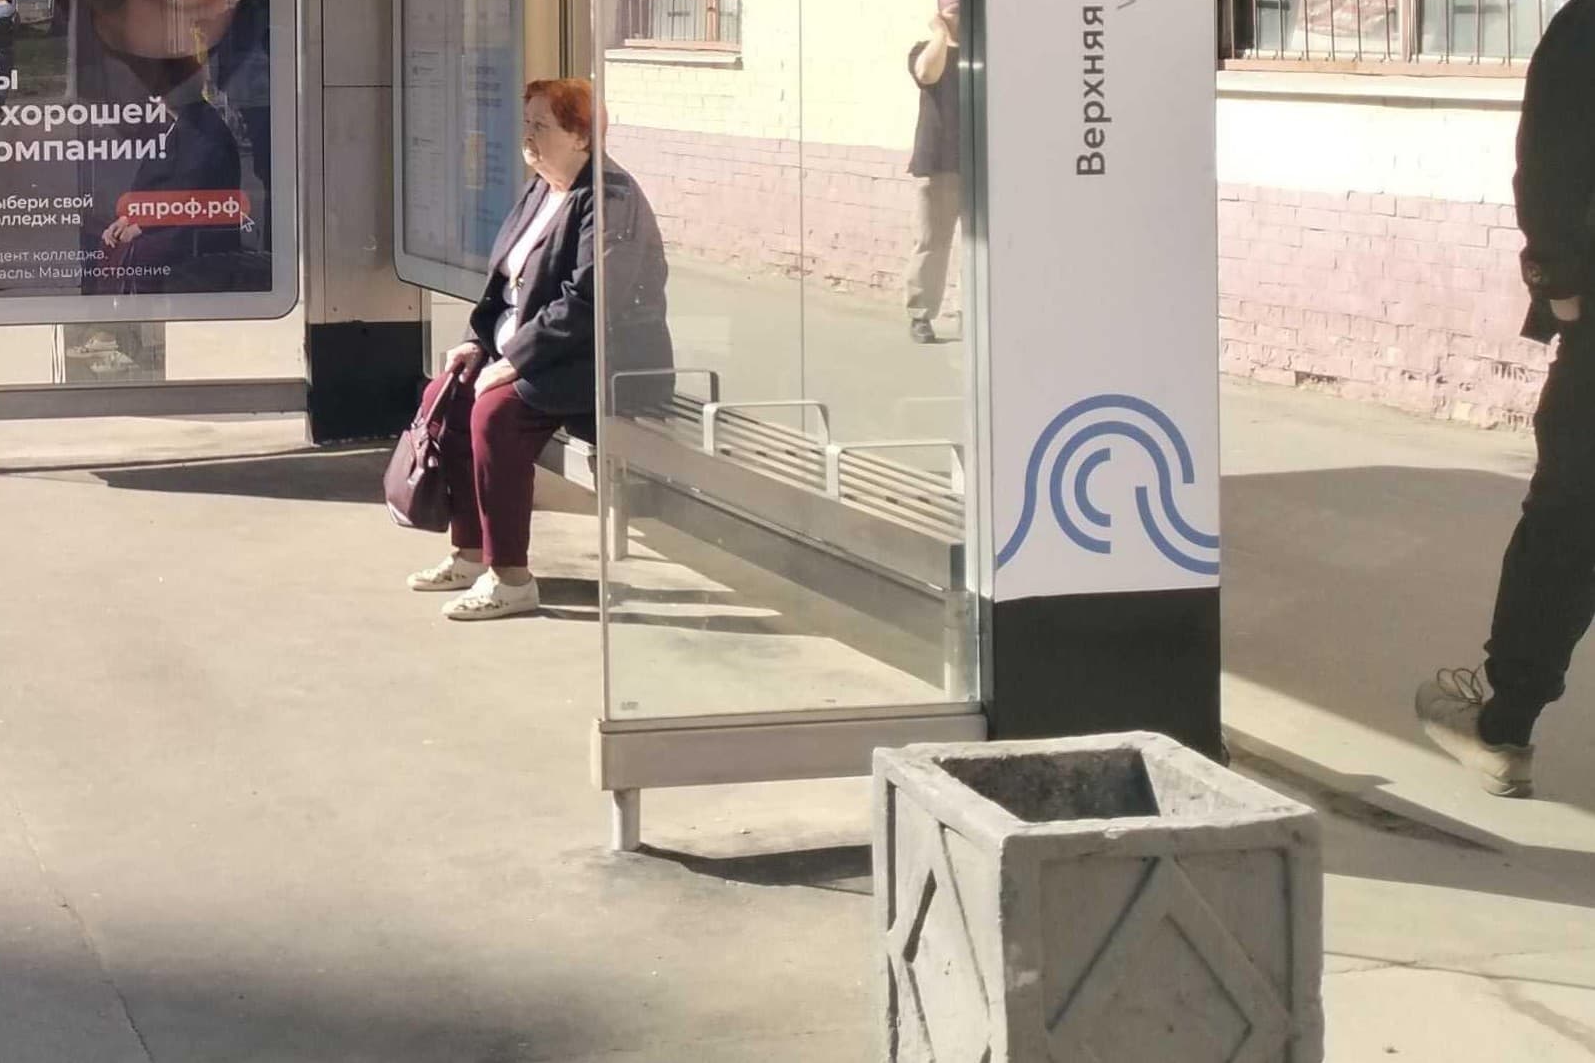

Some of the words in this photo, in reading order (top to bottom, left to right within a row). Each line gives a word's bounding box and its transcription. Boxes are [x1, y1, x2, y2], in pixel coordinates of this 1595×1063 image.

[1075, 5, 1112, 176] Верхняя
[0, 95, 167, 132] хорошей
[53, 193, 94, 209] свой
[127, 196, 241, 220] япроф.рф
[61, 213, 82, 225] на
[39, 264, 172, 280] Машиностроение
